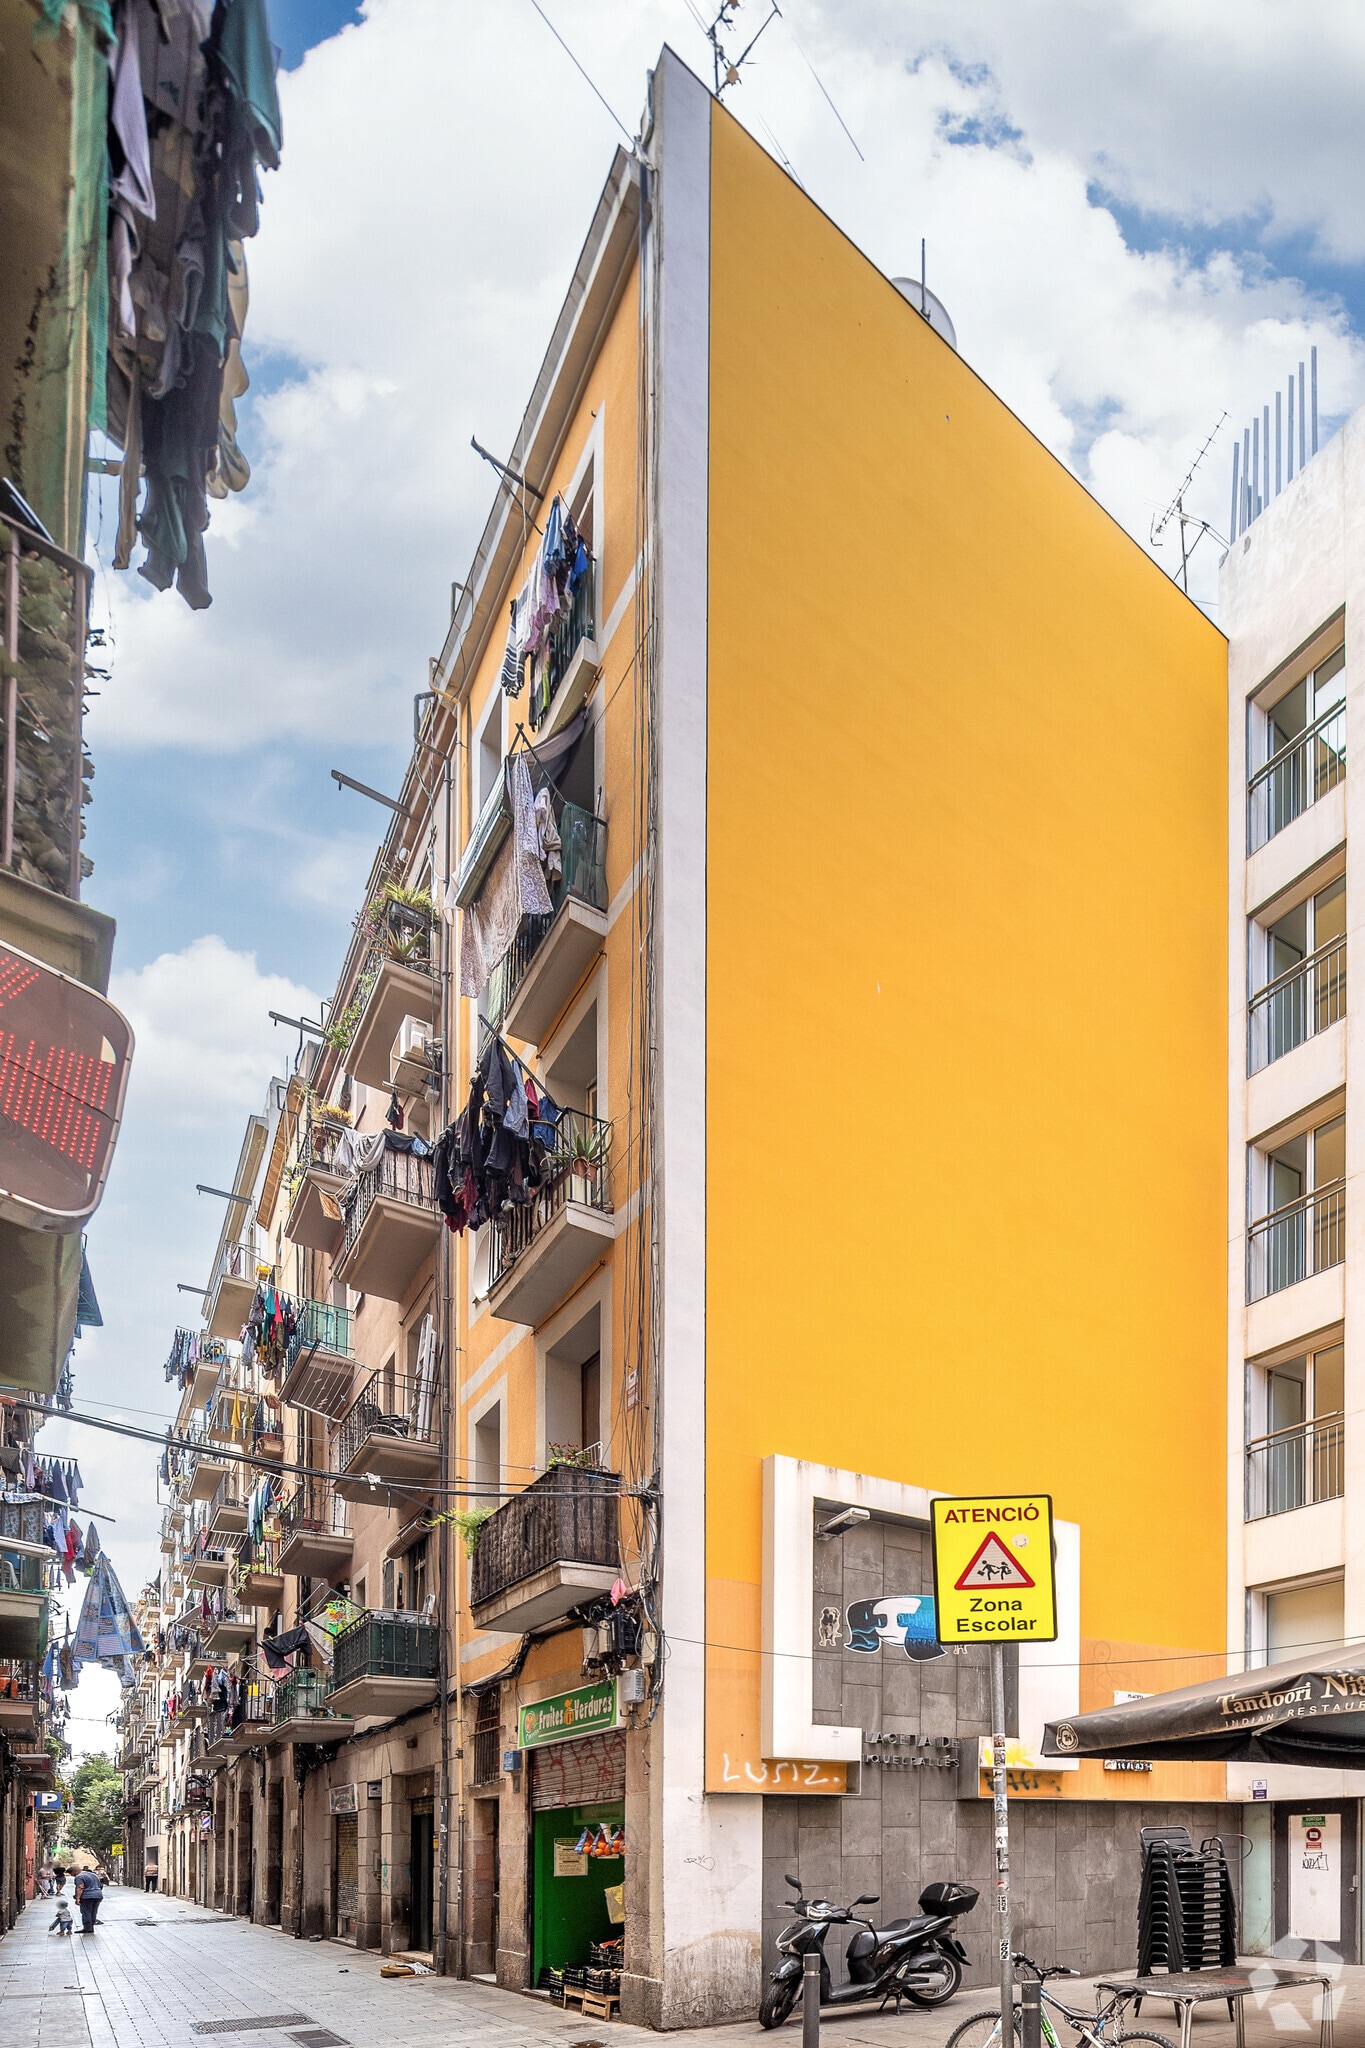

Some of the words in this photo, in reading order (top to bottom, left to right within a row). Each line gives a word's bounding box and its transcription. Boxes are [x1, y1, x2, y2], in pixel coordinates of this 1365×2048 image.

[945, 1503, 1039, 1523] ATENCIÓ
[970, 1598, 1022, 1612] Zona
[957, 1617, 1037, 1632] Escolar
[1216, 1682, 1312, 1715] Tandoori
[1225, 1713, 1274, 1727] INDIAN
[863, 1731, 932, 1747] LACETA
[936, 1736, 960, 1749] DE
[861, 1754, 907, 1766] IQUEL
[41, 1793, 58, 1806] P
